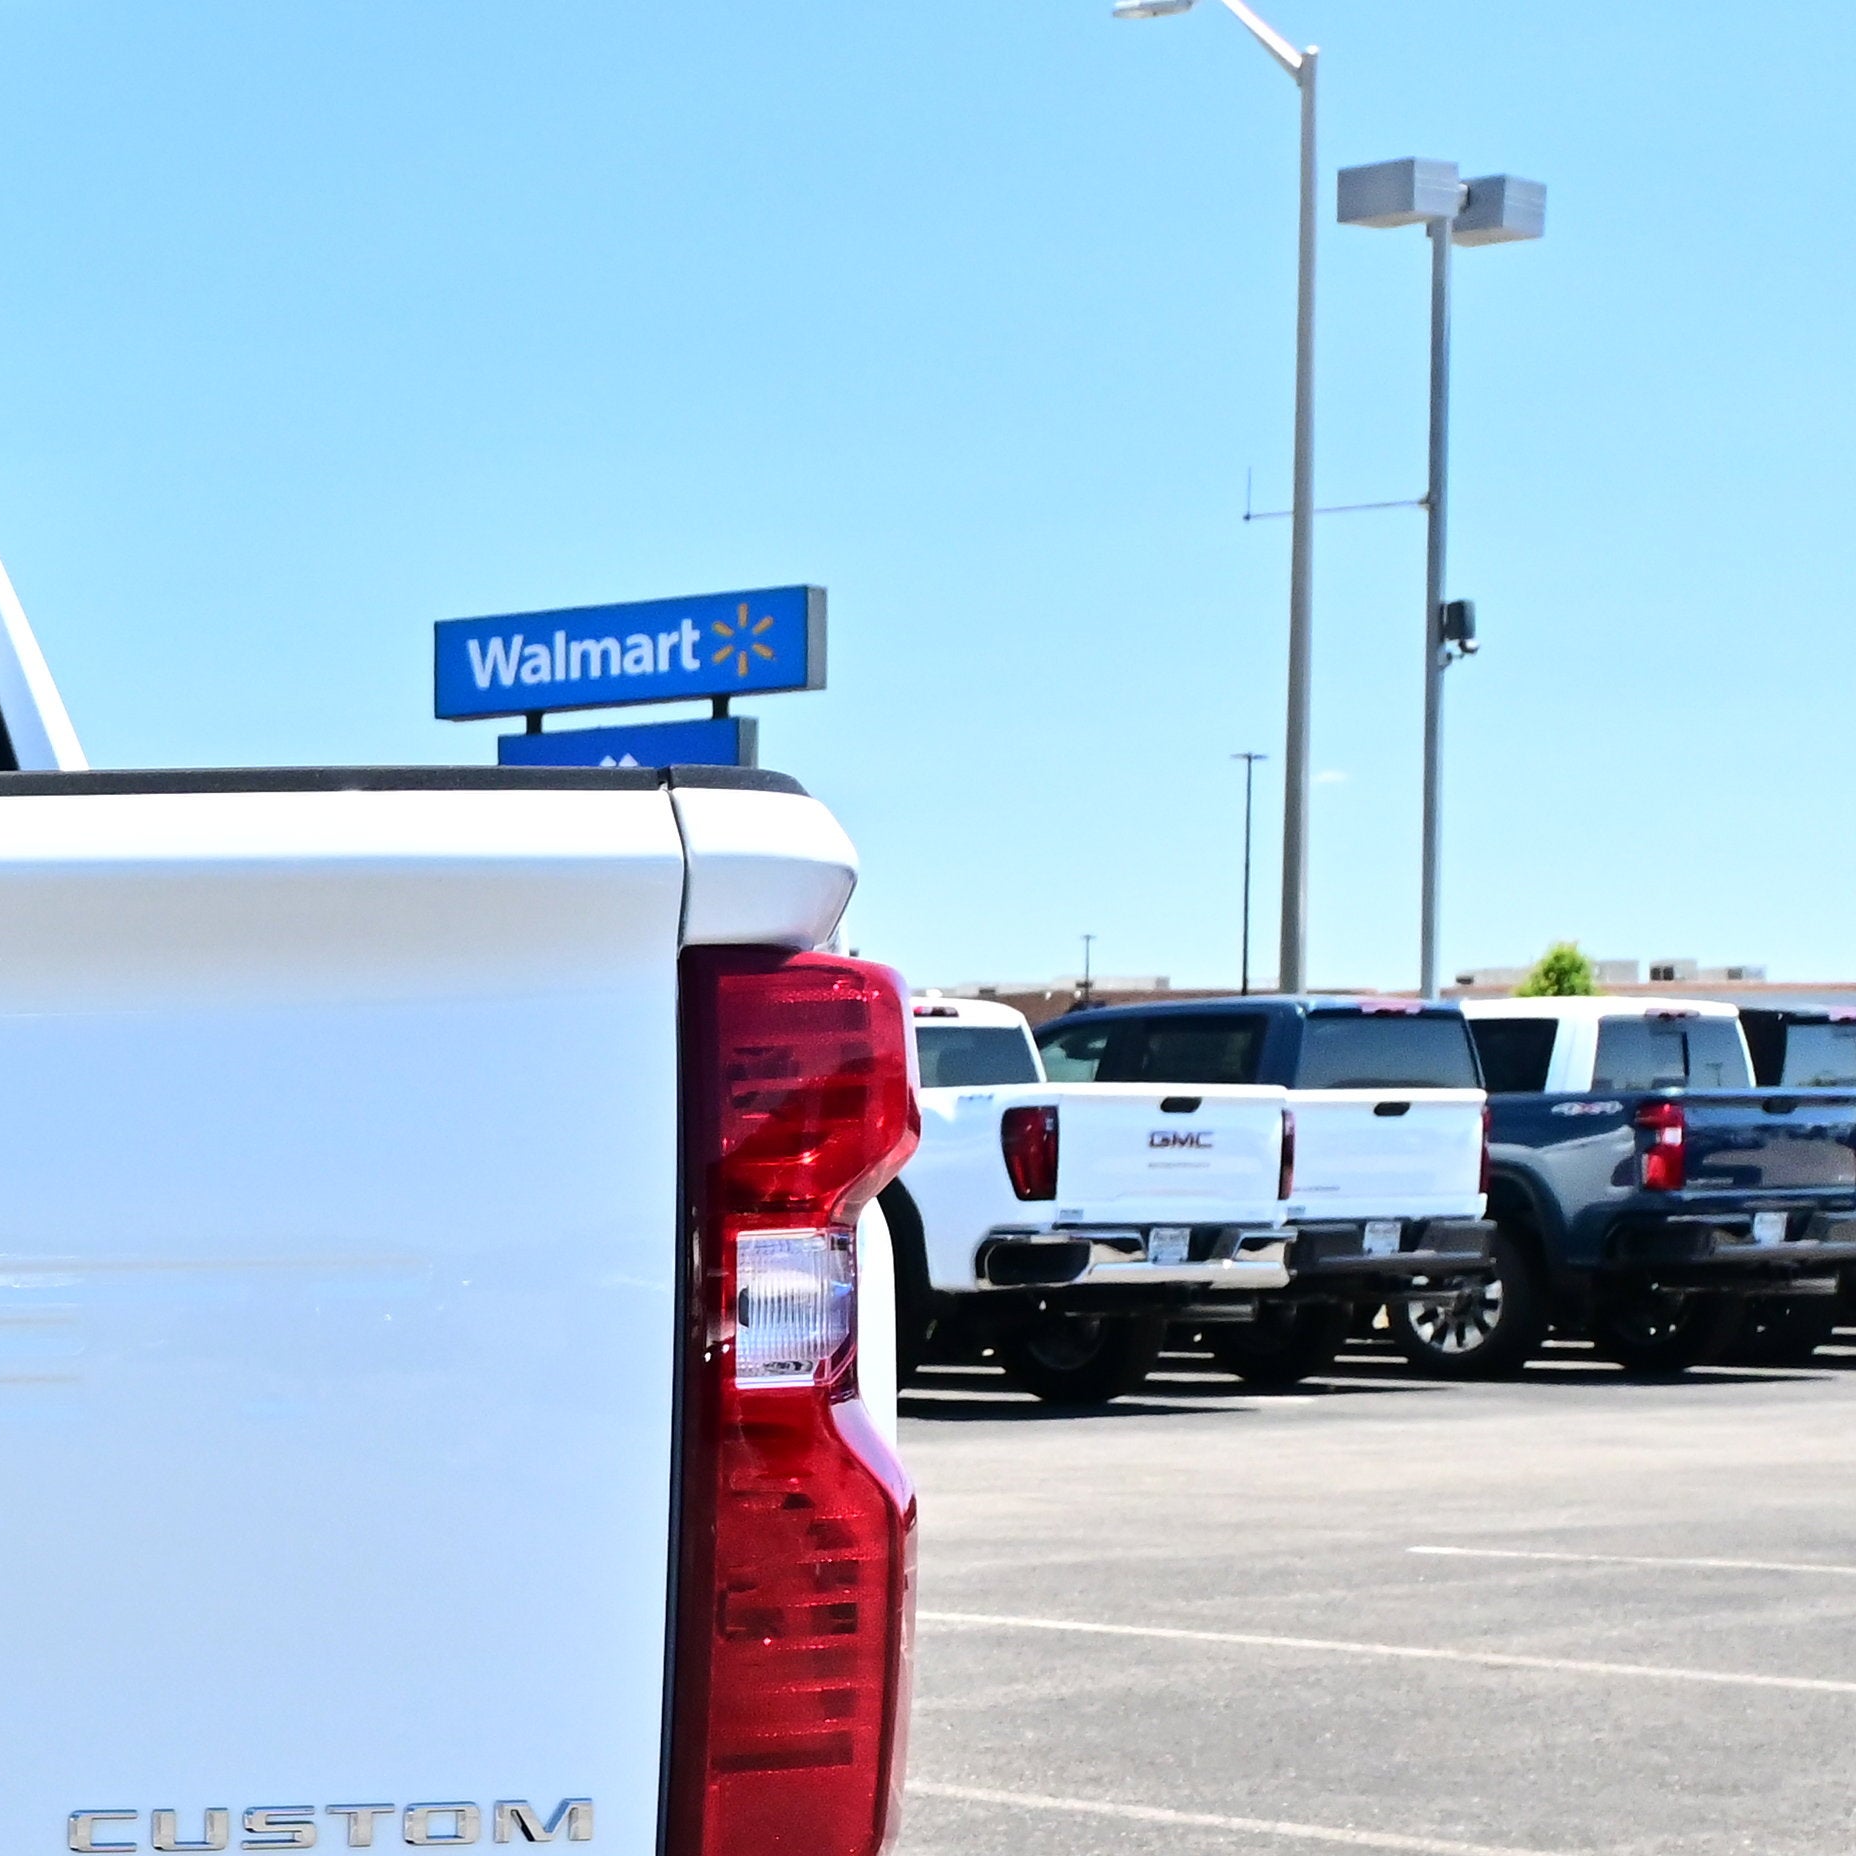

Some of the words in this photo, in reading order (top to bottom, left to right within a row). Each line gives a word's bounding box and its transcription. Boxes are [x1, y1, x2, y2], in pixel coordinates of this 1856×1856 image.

[466, 618, 701, 690] Walmart
[1148, 1130, 1214, 1148] GMC
[67, 1797, 593, 1852] CUSTOM
